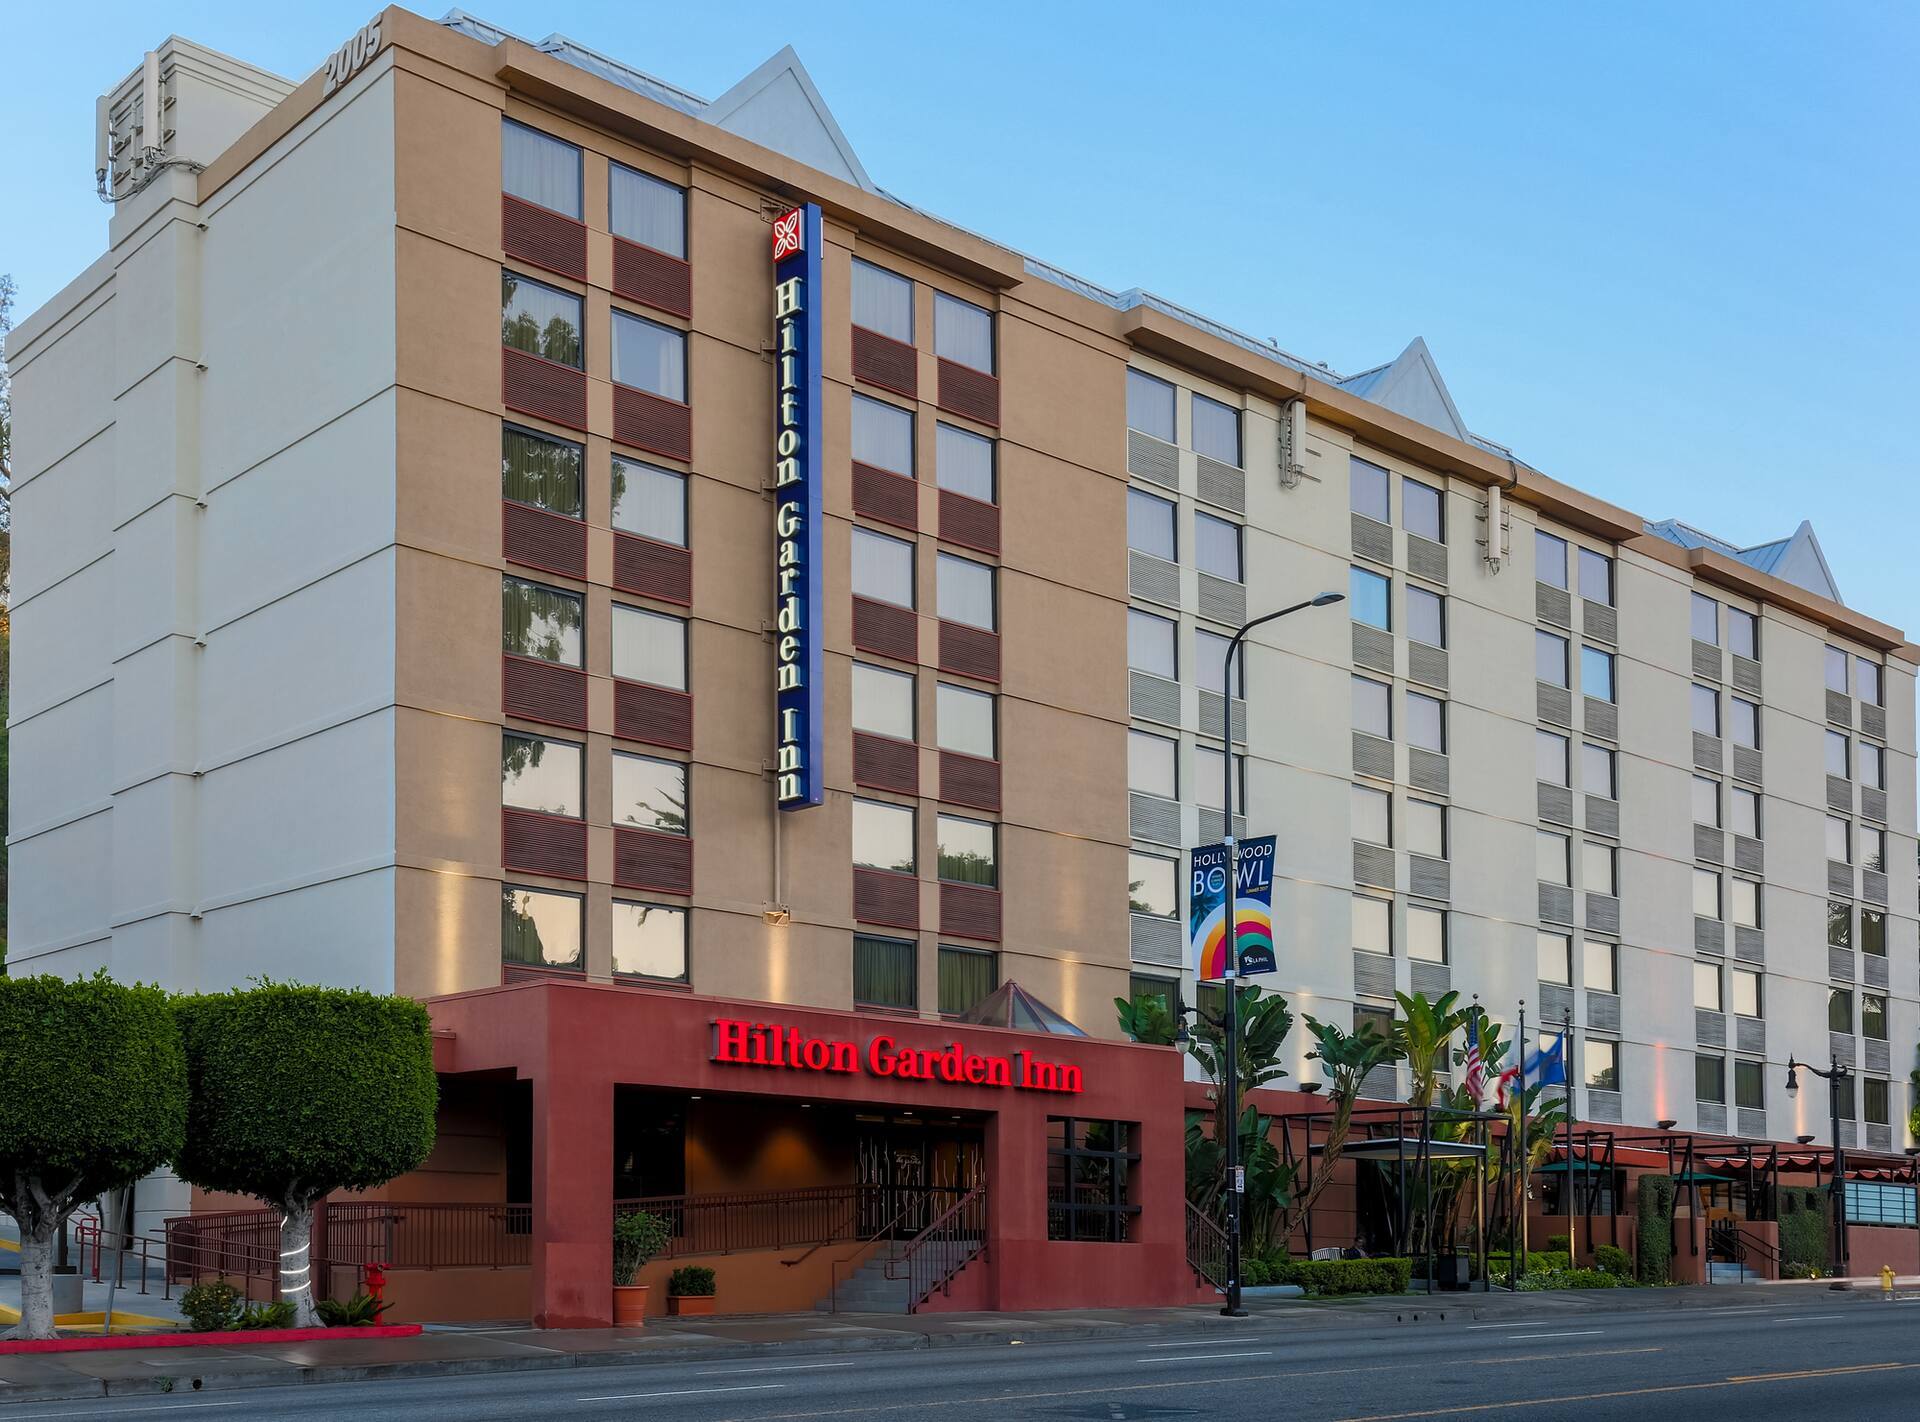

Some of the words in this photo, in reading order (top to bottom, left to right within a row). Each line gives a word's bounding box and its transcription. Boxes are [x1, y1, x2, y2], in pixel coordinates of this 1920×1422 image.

[322, 12, 383, 97] 2005
[775, 276, 803, 488] Hilton
[777, 501, 803, 691] Garden
[778, 708, 803, 801] Inn
[1193, 860, 1269, 896] BOWL
[713, 1018, 860, 1073] Hilton
[868, 1035, 1012, 1088] Garden
[1019, 1050, 1085, 1094] Inn
